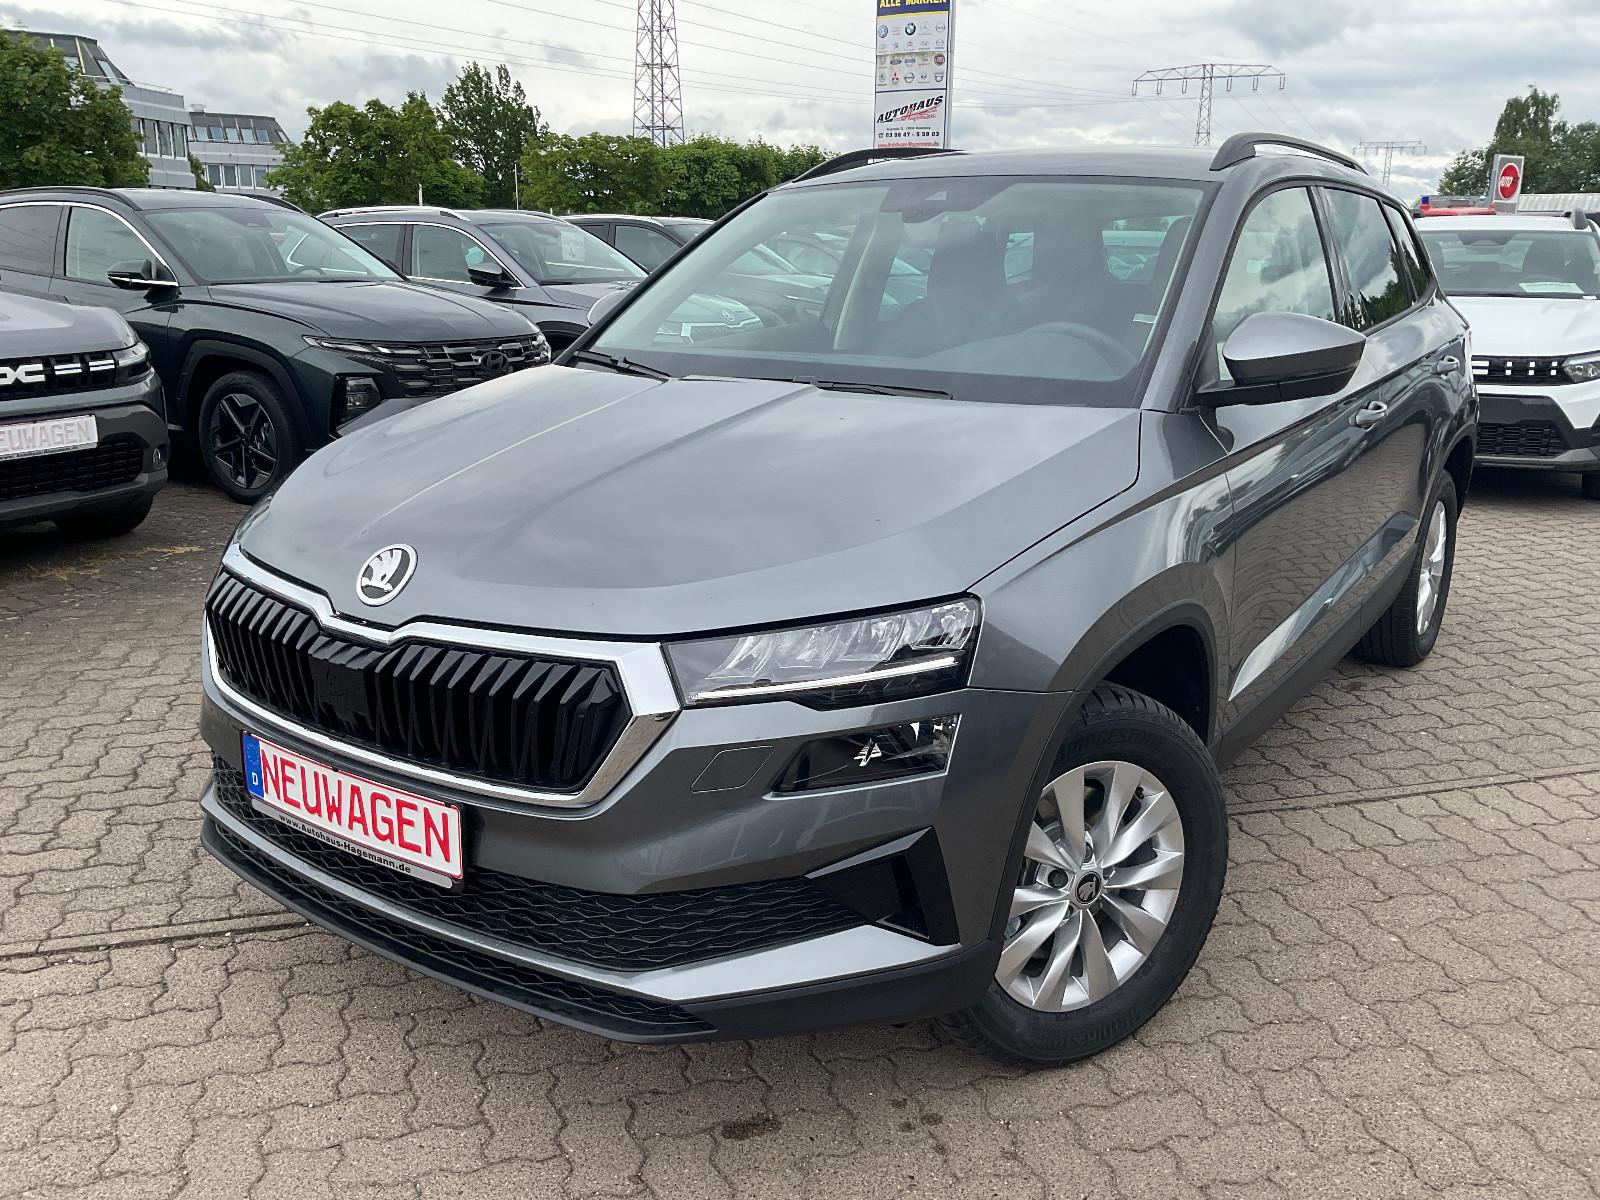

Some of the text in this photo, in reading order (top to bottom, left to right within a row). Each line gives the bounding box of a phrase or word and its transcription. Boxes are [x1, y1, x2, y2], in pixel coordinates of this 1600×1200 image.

[880, 0, 901, 8] ALLE
[876, 95, 944, 123] AUTOHAUS
[252, 748, 451, 863] D NEUWAGEN
[278, 814, 412, 874] www.Autohaus-Hagemann.de
